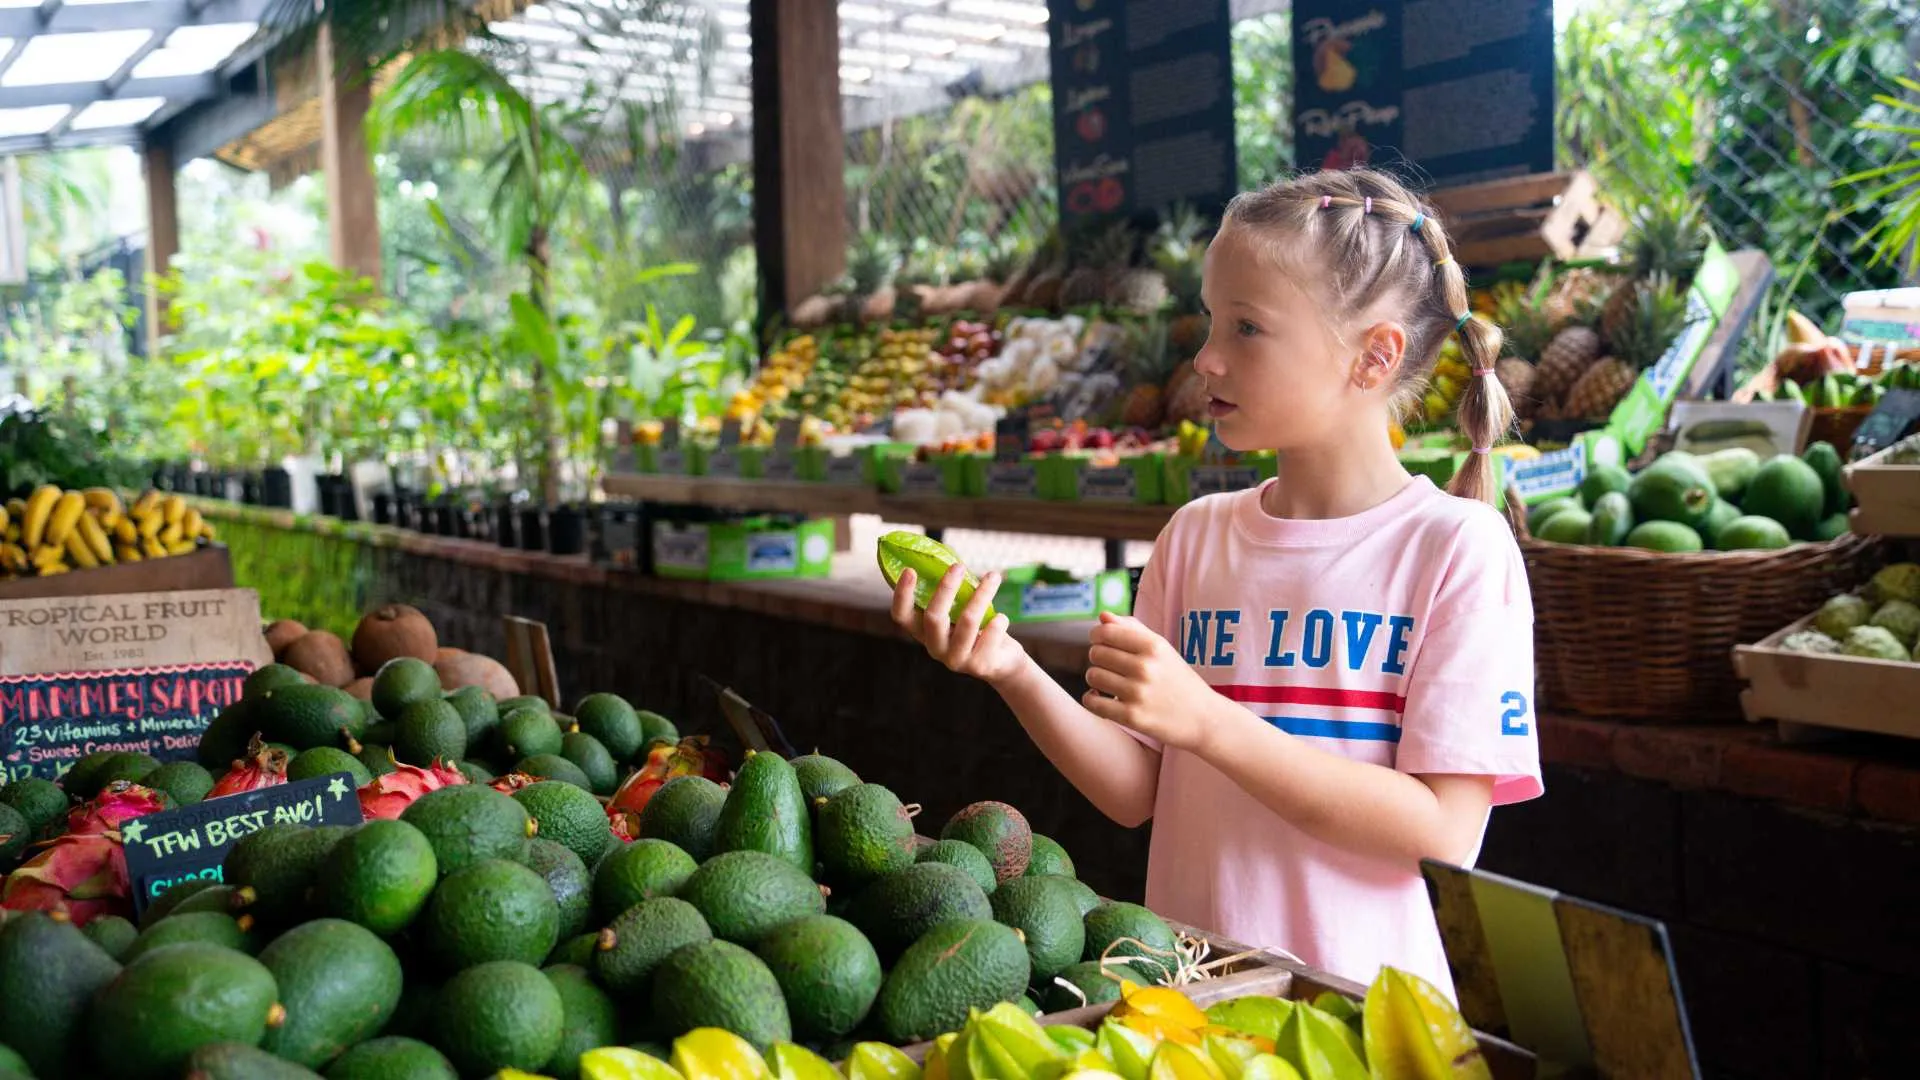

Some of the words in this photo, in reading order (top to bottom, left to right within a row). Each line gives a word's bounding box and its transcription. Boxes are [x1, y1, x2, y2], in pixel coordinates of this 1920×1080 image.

[144, 600, 226, 619] FRUIT
[55, 624, 167, 646] WORLD
[1181, 610, 1241, 666] NE
[1264, 609, 1415, 676] LOVE
[1501, 691, 1530, 736] 2
[15, 724, 42, 745] 23
[45, 721, 121, 742] Vitamins
[28, 745, 82, 762] Sweet
[145, 828, 200, 858] TFW
[205, 810, 269, 847] BEST
[273, 795, 323, 824] AVO!
